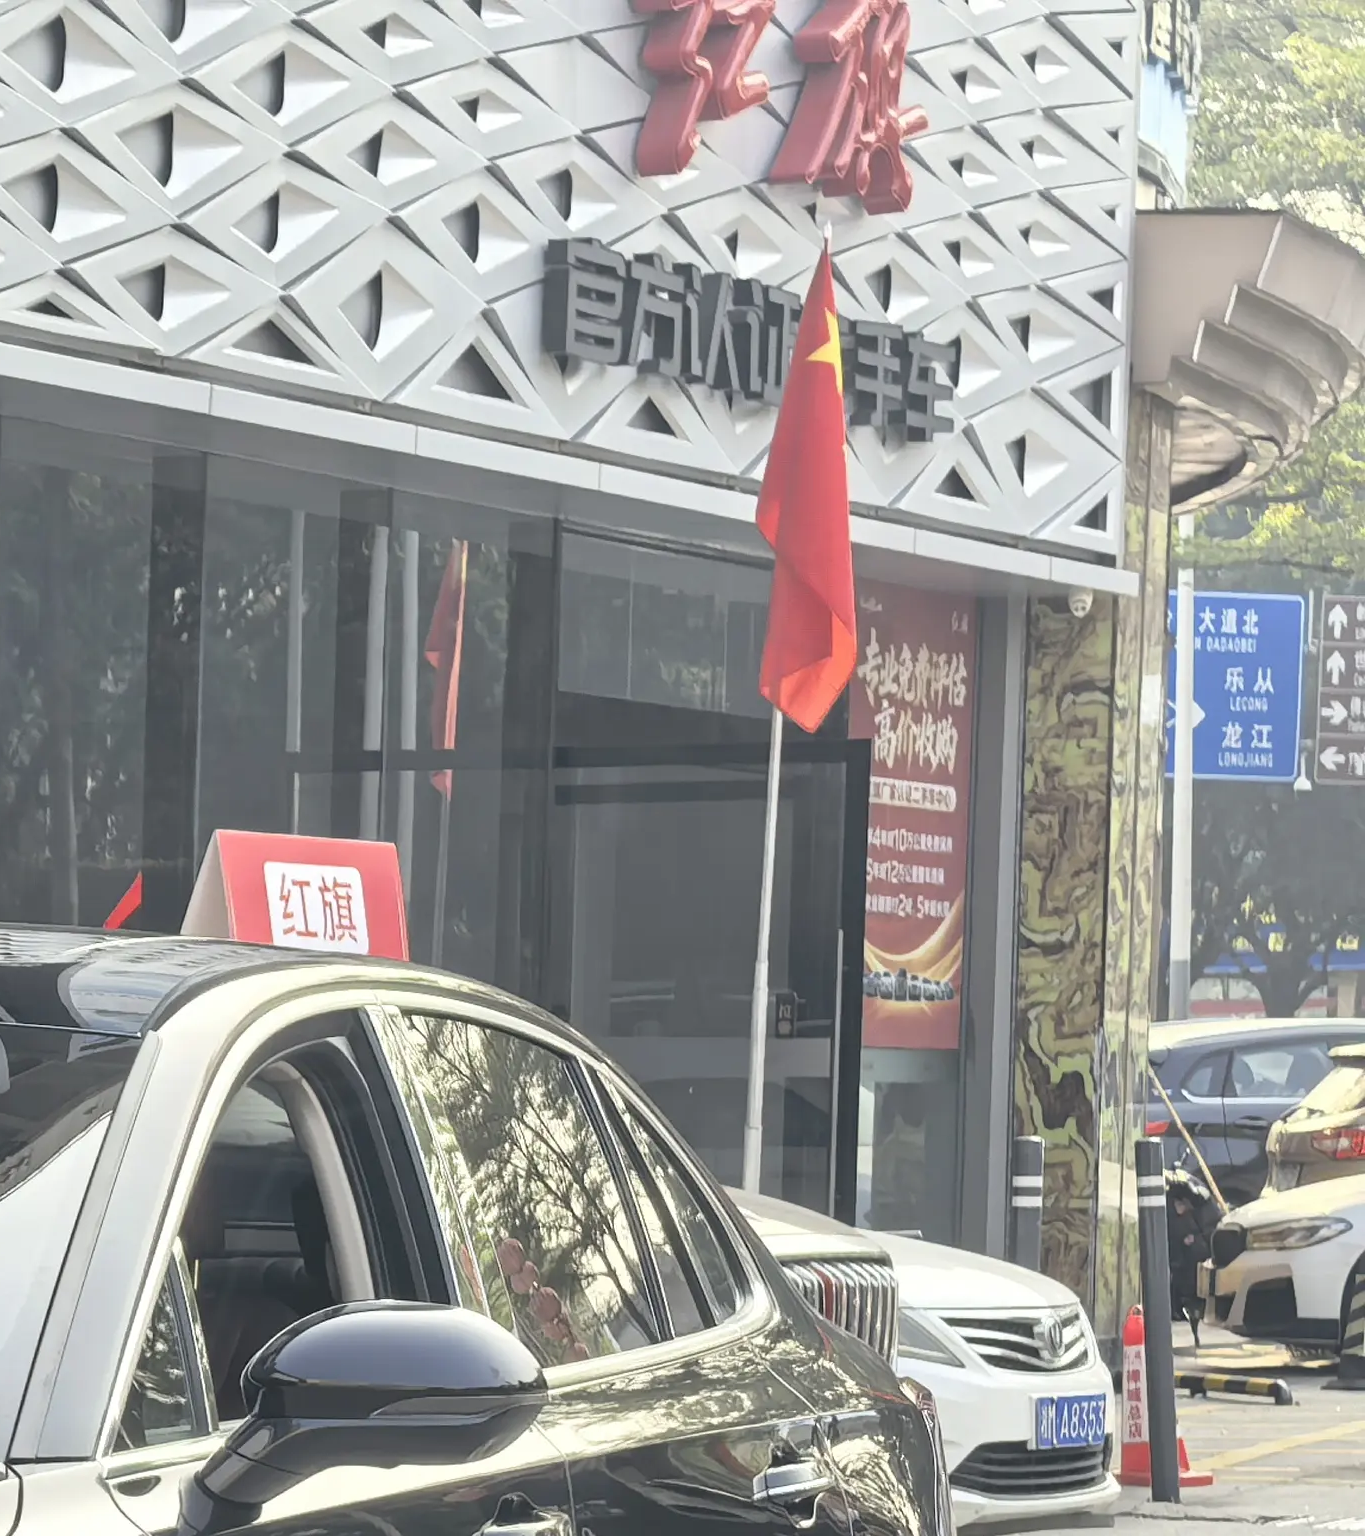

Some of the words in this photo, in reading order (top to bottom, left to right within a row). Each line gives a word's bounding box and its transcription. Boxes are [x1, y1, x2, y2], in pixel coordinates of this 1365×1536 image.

[547, 238, 959, 442] 官方认证手车
[1199, 606, 1259, 635] 大道北
[857, 626, 967, 715] 专业免费评估
[1224, 667, 1275, 695] 乐从
[873, 698, 959, 775] 高价收购
[1221, 721, 1273, 749] 龙江
[279, 872, 357, 943] 红旗
